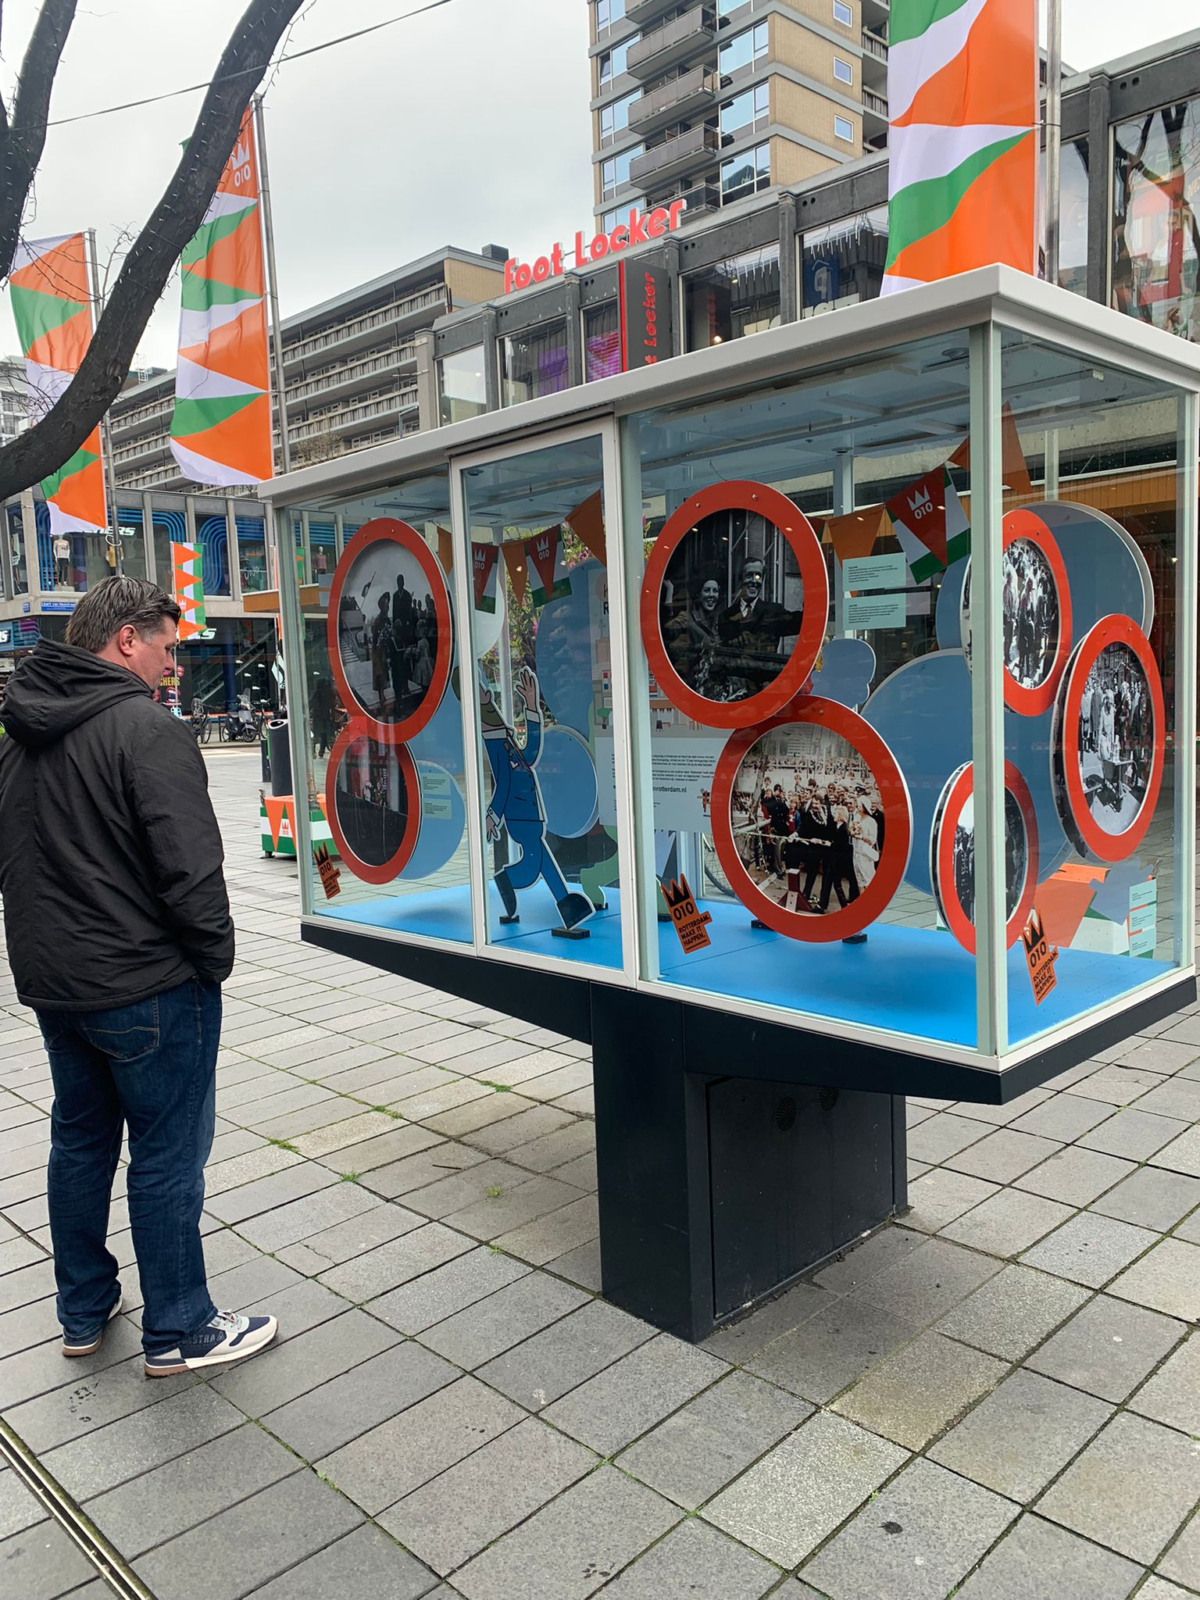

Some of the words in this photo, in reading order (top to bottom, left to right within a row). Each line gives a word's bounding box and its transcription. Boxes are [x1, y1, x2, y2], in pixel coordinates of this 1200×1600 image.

[234, 164, 251, 187] 010
[504, 242, 565, 294] Foot
[575, 199, 687, 268] Locker
[643, 272, 657, 347] Locker
[914, 502, 933, 520] 010
[538, 550, 550, 560] 010
[320, 861, 331, 876] 010
[673, 902, 695, 921] 010
[1030, 941, 1047, 968] 010
